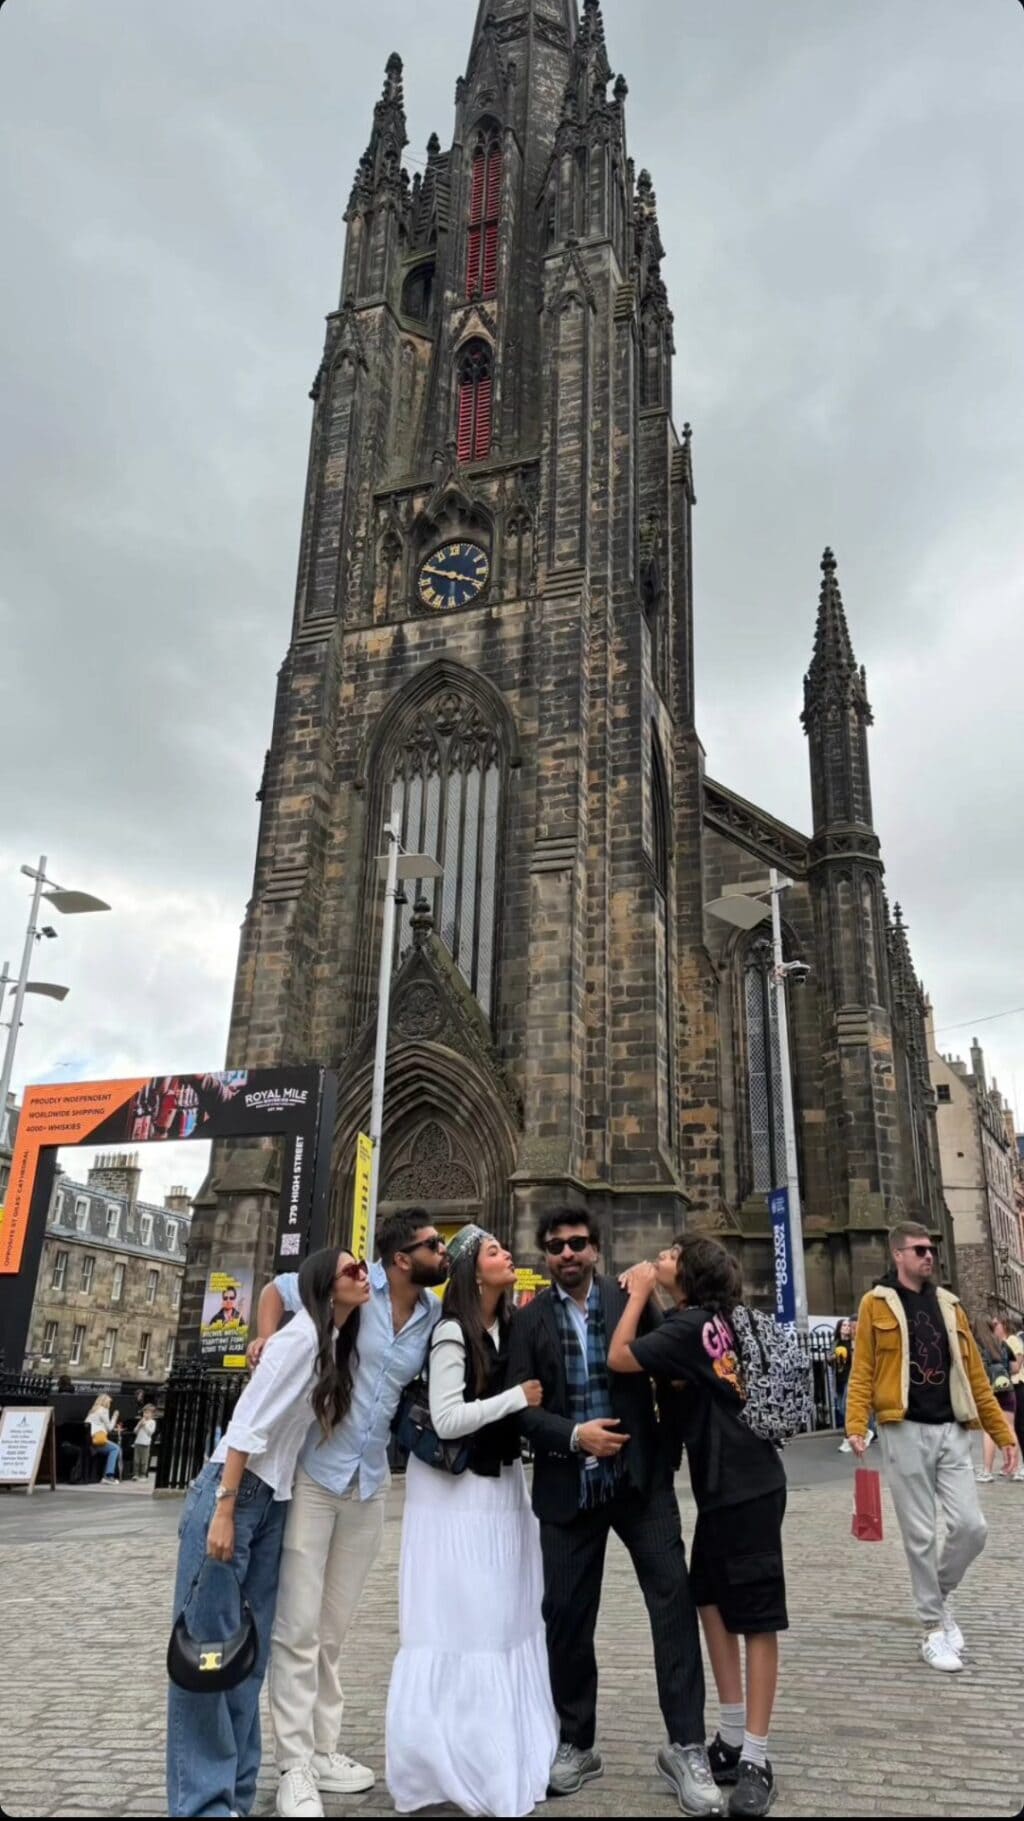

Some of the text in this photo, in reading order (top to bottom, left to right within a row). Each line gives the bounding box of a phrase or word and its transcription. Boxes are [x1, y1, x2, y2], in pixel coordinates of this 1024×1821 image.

[30, 1093, 112, 1105] PROUDLY INDEPENDENT
[245, 1087, 309, 1105] ROYAL MILE
[29, 1107, 105, 1119] WORLDWIDE SHIPPING
[48, 1122, 81, 1131] WHISKIES
[17, 1151, 29, 1193] CATHEDRAL
[288, 1136, 304, 1225] 379 HIGH STREET
[779, 1223, 788, 1285] TATTOO
[773, 1225, 784, 1314] BOX OFFICE
